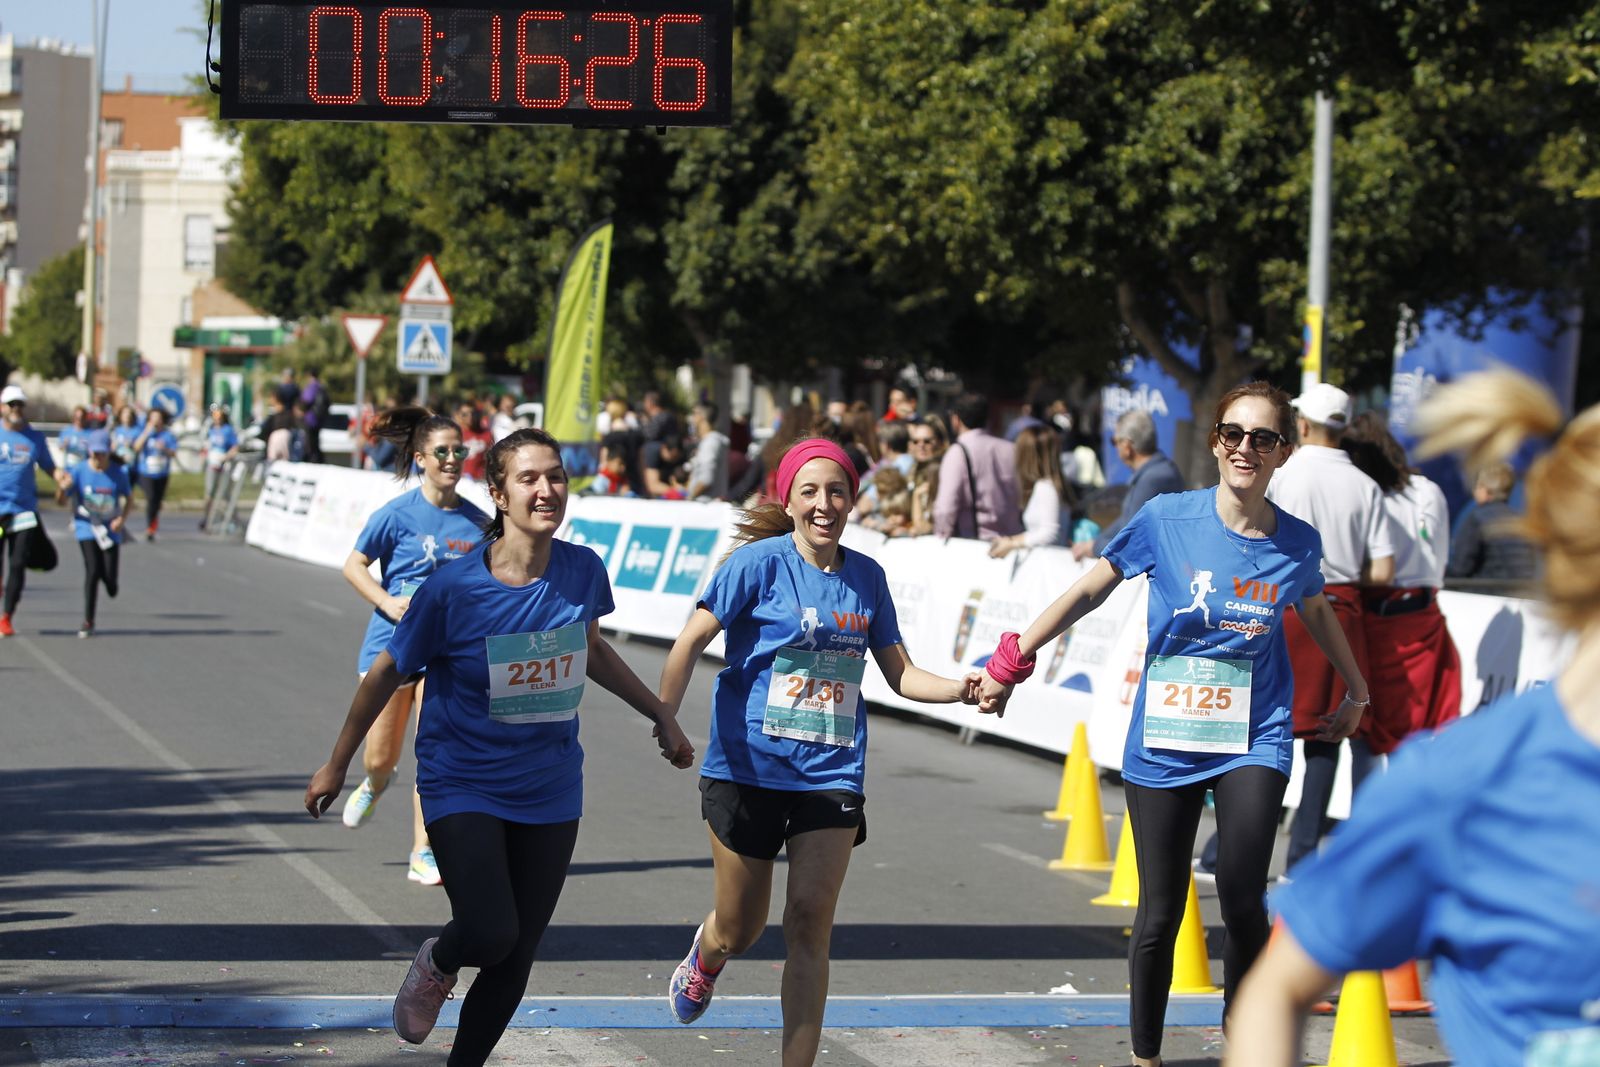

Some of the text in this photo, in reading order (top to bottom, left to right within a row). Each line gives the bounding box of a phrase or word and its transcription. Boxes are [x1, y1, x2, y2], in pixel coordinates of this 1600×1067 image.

[1232, 575, 1280, 605] VIII
[1225, 601, 1275, 617] CARRERA
[832, 610, 869, 633] VIII
[1219, 617, 1271, 641] mujer
[541, 631, 556, 640] VIII
[824, 655, 838, 663] VIII
[1199, 658, 1216, 668] VIII
[507, 654, 574, 686] 2217
[530, 681, 556, 690] ELENA
[786, 676, 845, 704] 2136
[804, 699, 828, 709] MARTA
[1163, 683, 1232, 710] 2125
[1181, 708, 1211, 717] MAMEN
